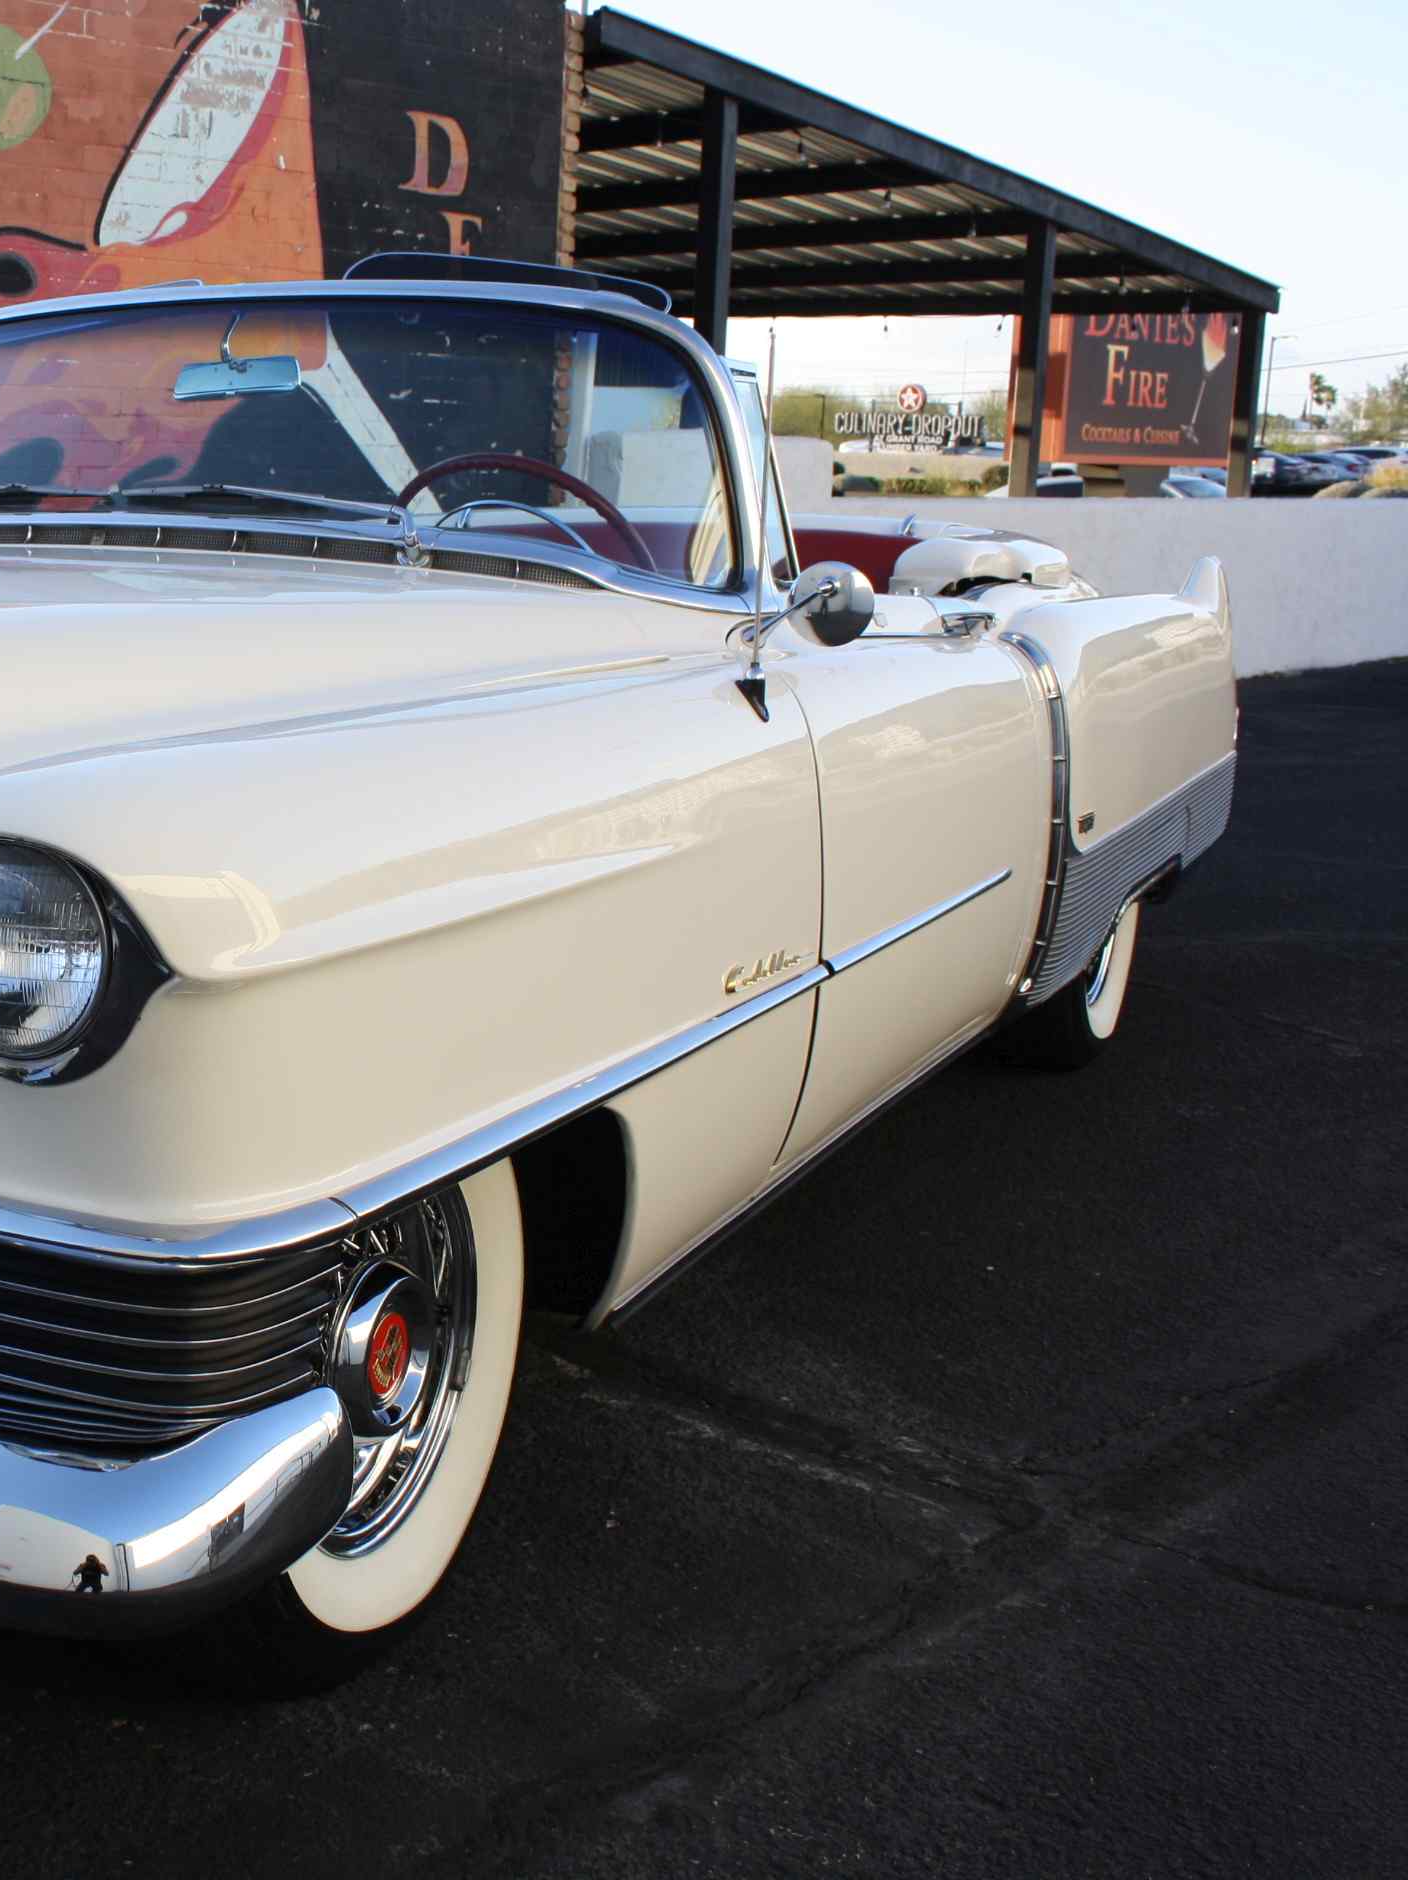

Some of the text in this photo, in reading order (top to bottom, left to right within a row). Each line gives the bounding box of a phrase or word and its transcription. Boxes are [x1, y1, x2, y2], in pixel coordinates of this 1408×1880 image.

[398, 110, 469, 196] D
[1102, 343, 1169, 409] FIRE
[834, 412, 982, 437] CULINARY DROPOUT
[886, 434, 916, 444] GRANT
[917, 435, 943, 445] ROAD
